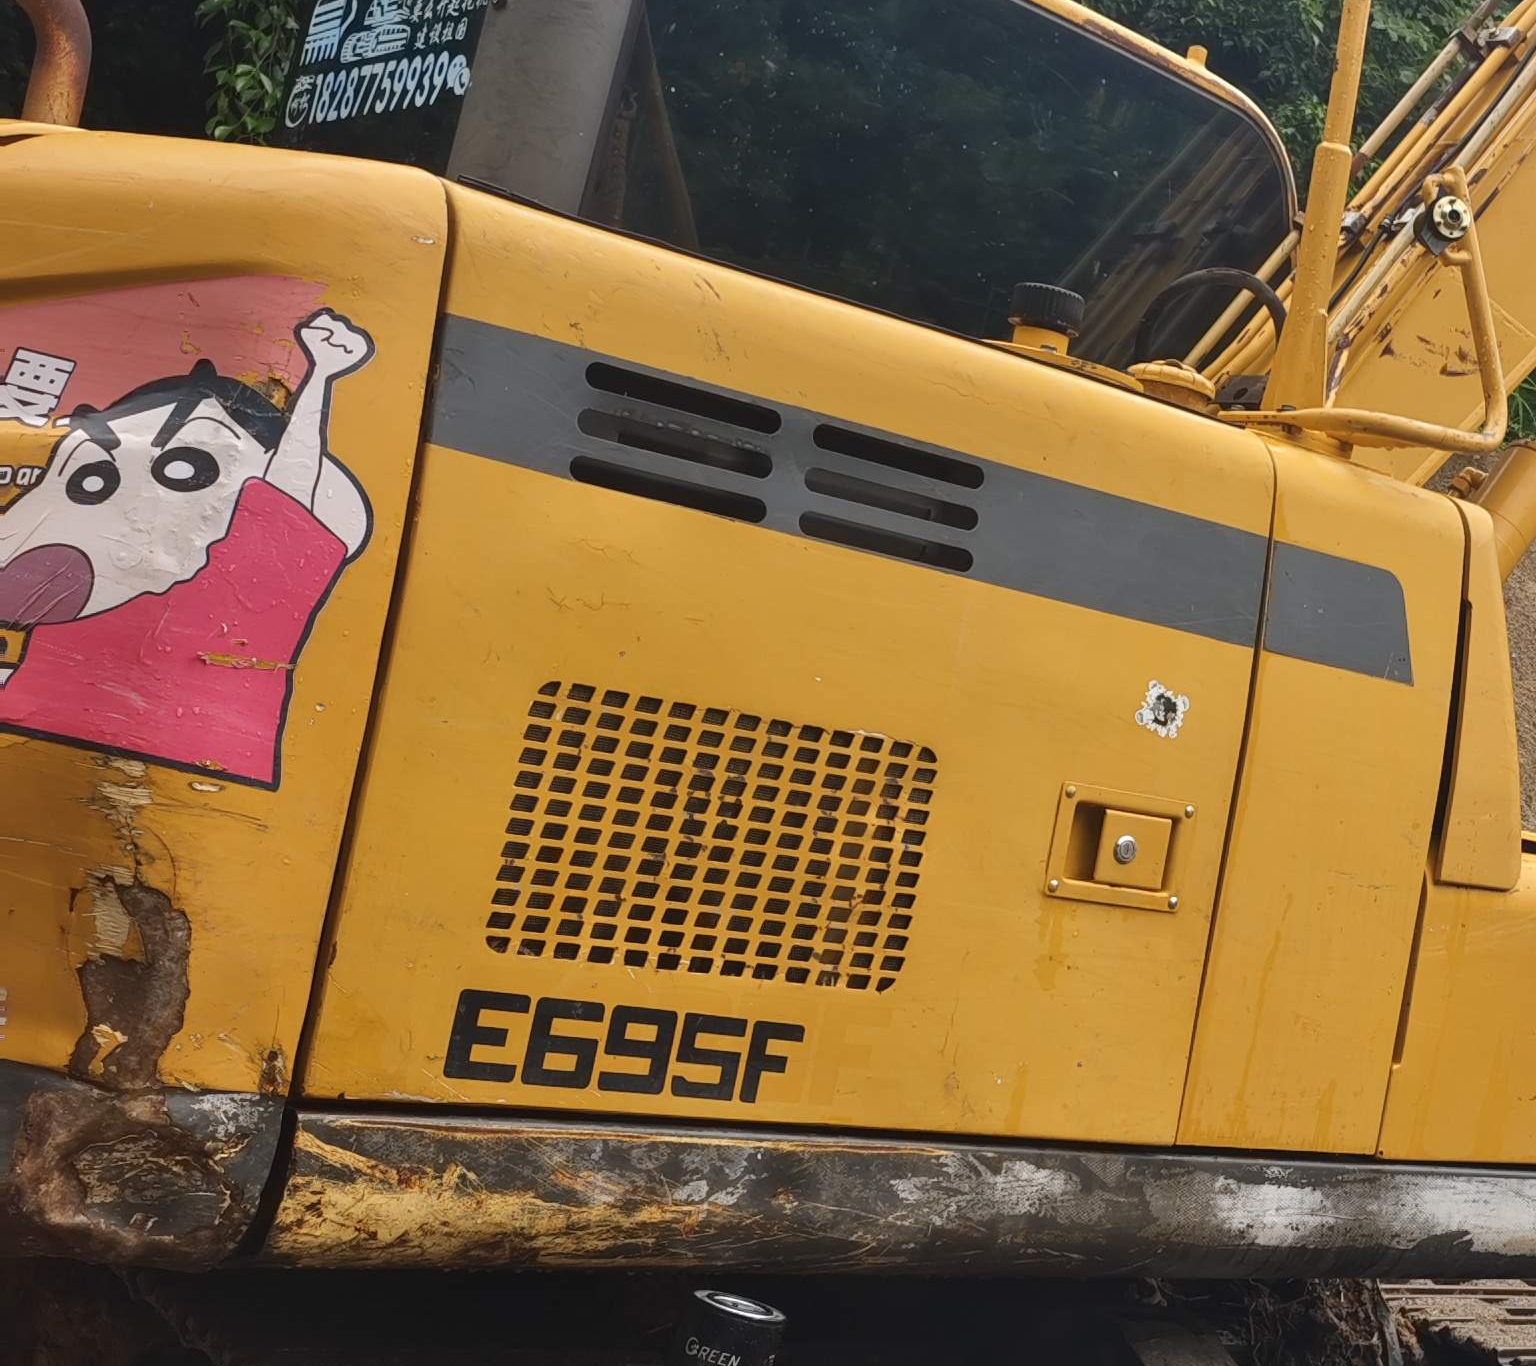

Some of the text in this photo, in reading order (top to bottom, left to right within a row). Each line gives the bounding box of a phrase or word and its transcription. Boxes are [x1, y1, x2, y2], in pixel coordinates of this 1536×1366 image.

[413, 17, 468, 50] 建设祖国
[308, 50, 450, 125] 18287759939
[443, 988, 806, 1104] E695F
